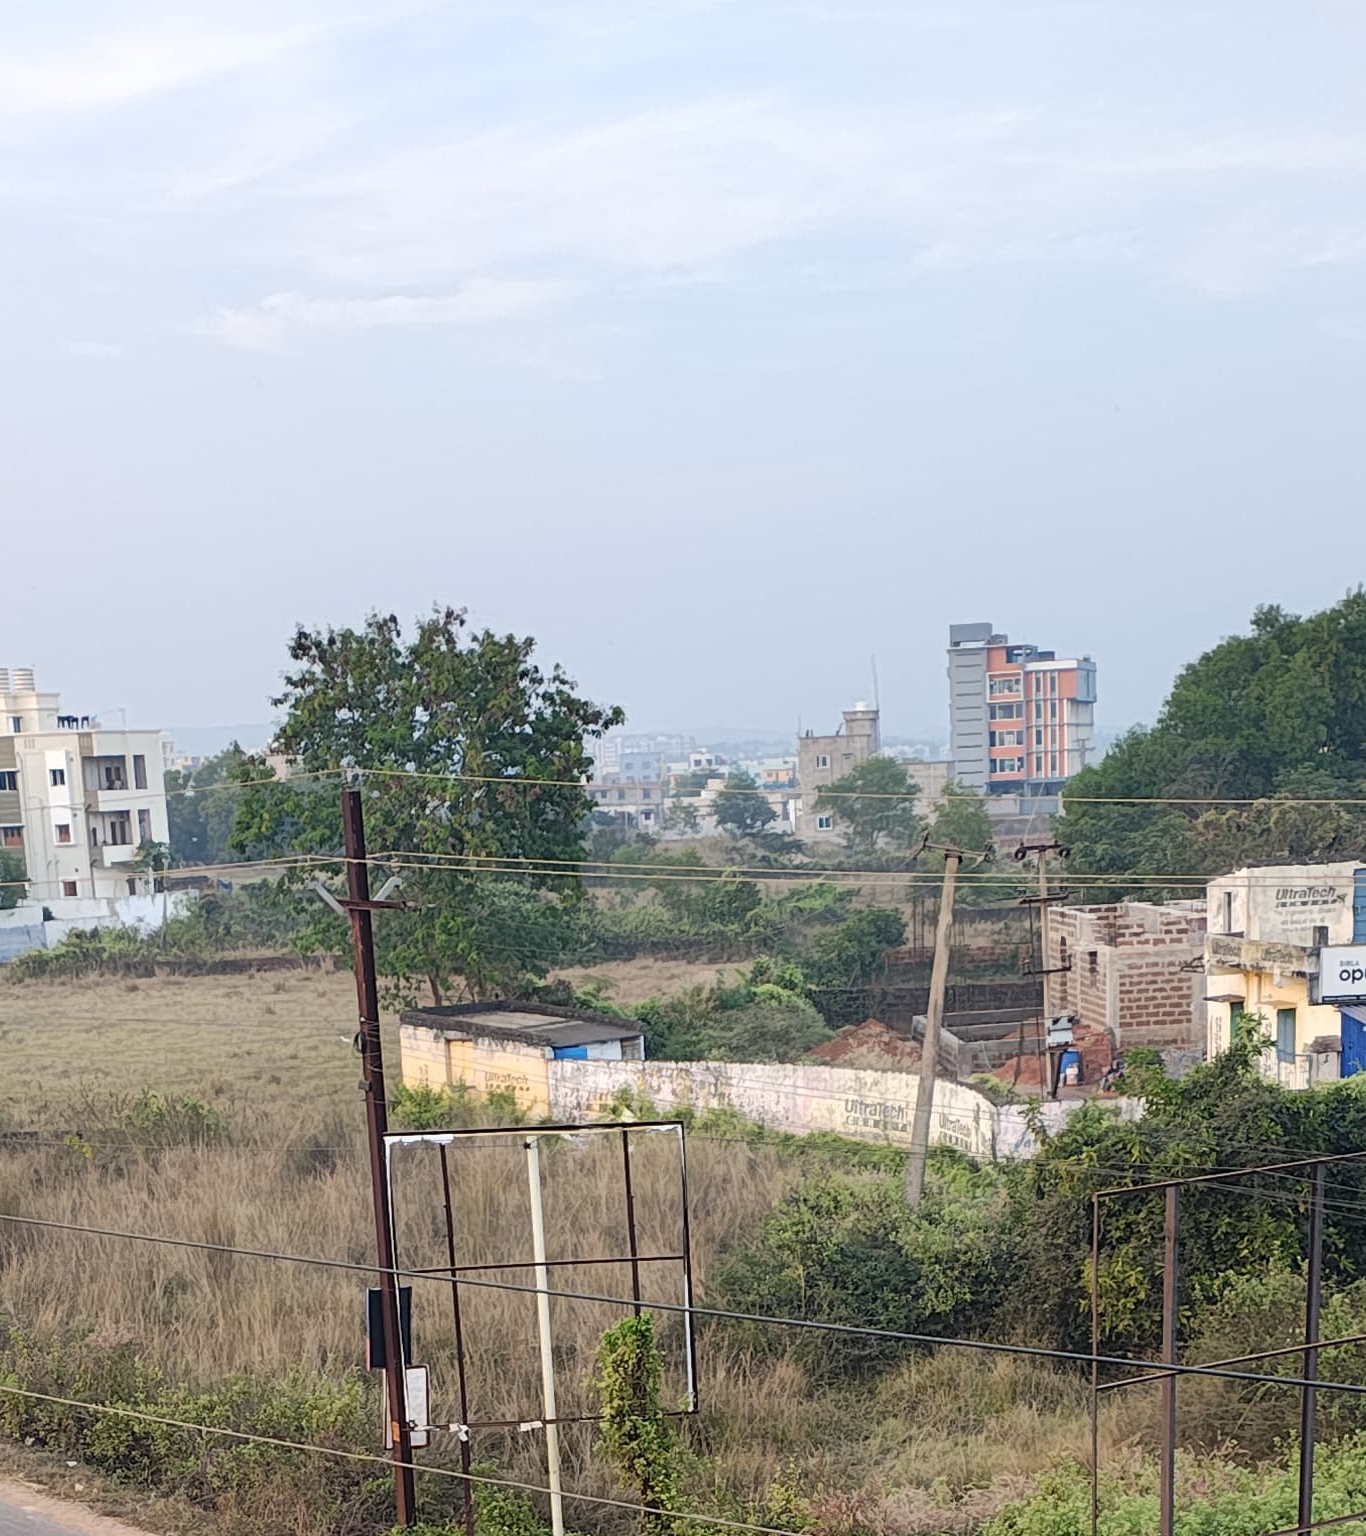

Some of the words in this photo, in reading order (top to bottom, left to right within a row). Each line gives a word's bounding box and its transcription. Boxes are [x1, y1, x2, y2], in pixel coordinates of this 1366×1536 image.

[1275, 886, 1336, 901] UltraTech
[484, 1071, 529, 1086] UltraTech
[844, 1099, 908, 1121] UltraTech
